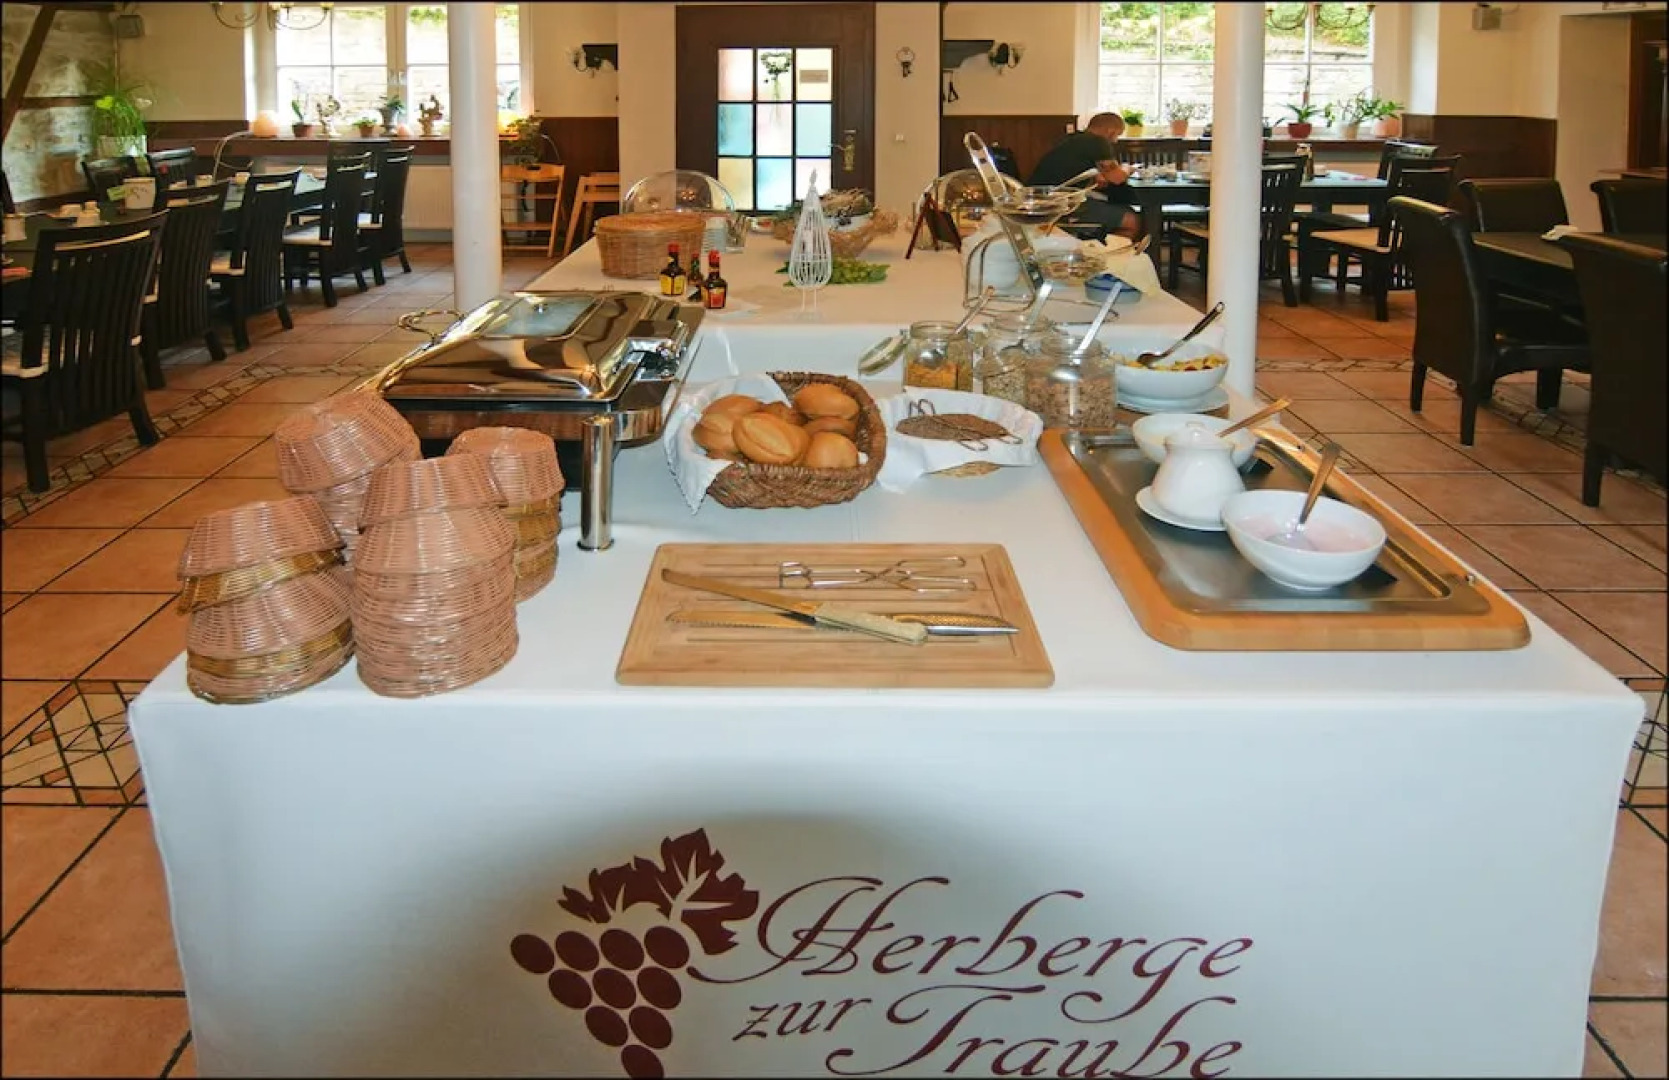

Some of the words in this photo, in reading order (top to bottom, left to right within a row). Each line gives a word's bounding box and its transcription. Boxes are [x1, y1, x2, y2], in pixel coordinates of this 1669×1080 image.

[687, 876, 1253, 1023] Herberge
[732, 997, 872, 1041] zur
[825, 984, 1244, 1078] Traube
